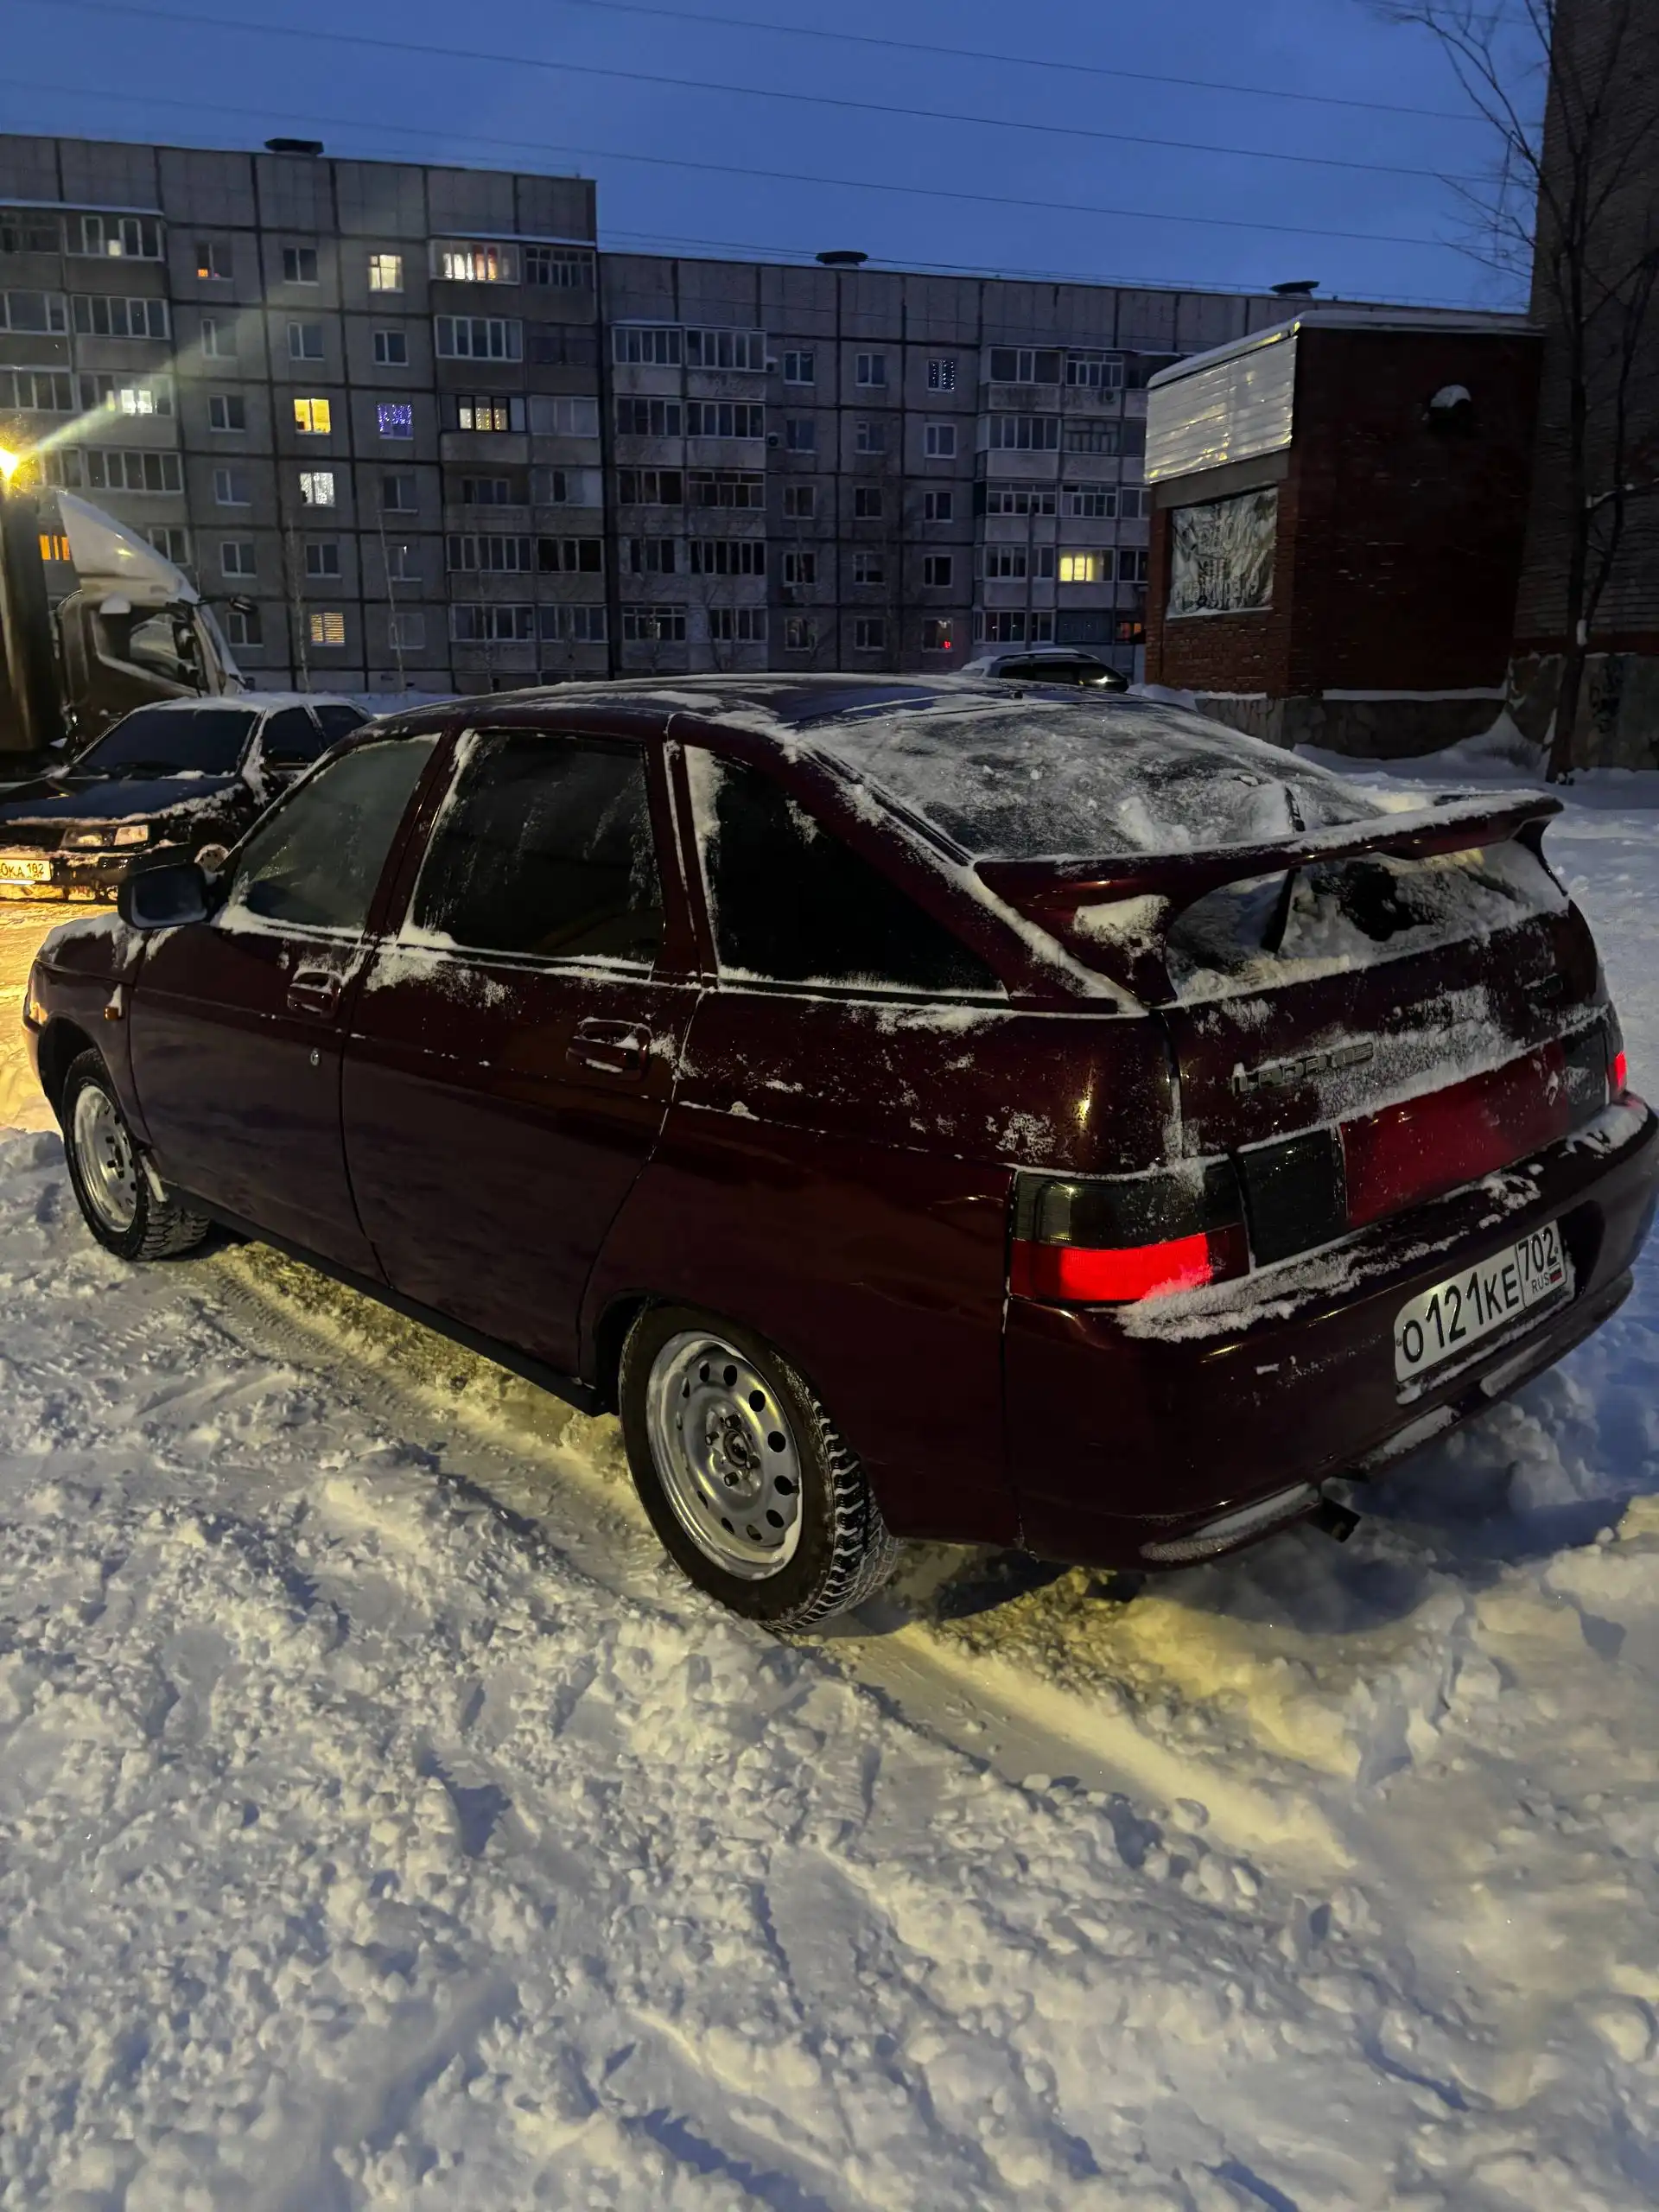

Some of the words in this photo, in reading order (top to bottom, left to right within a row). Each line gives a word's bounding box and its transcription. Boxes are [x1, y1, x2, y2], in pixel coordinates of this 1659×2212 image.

[1402, 1263, 1520, 1363] O121KE
[1518, 1226, 1558, 1281] 702
[1531, 1274, 1550, 1294] RUS
